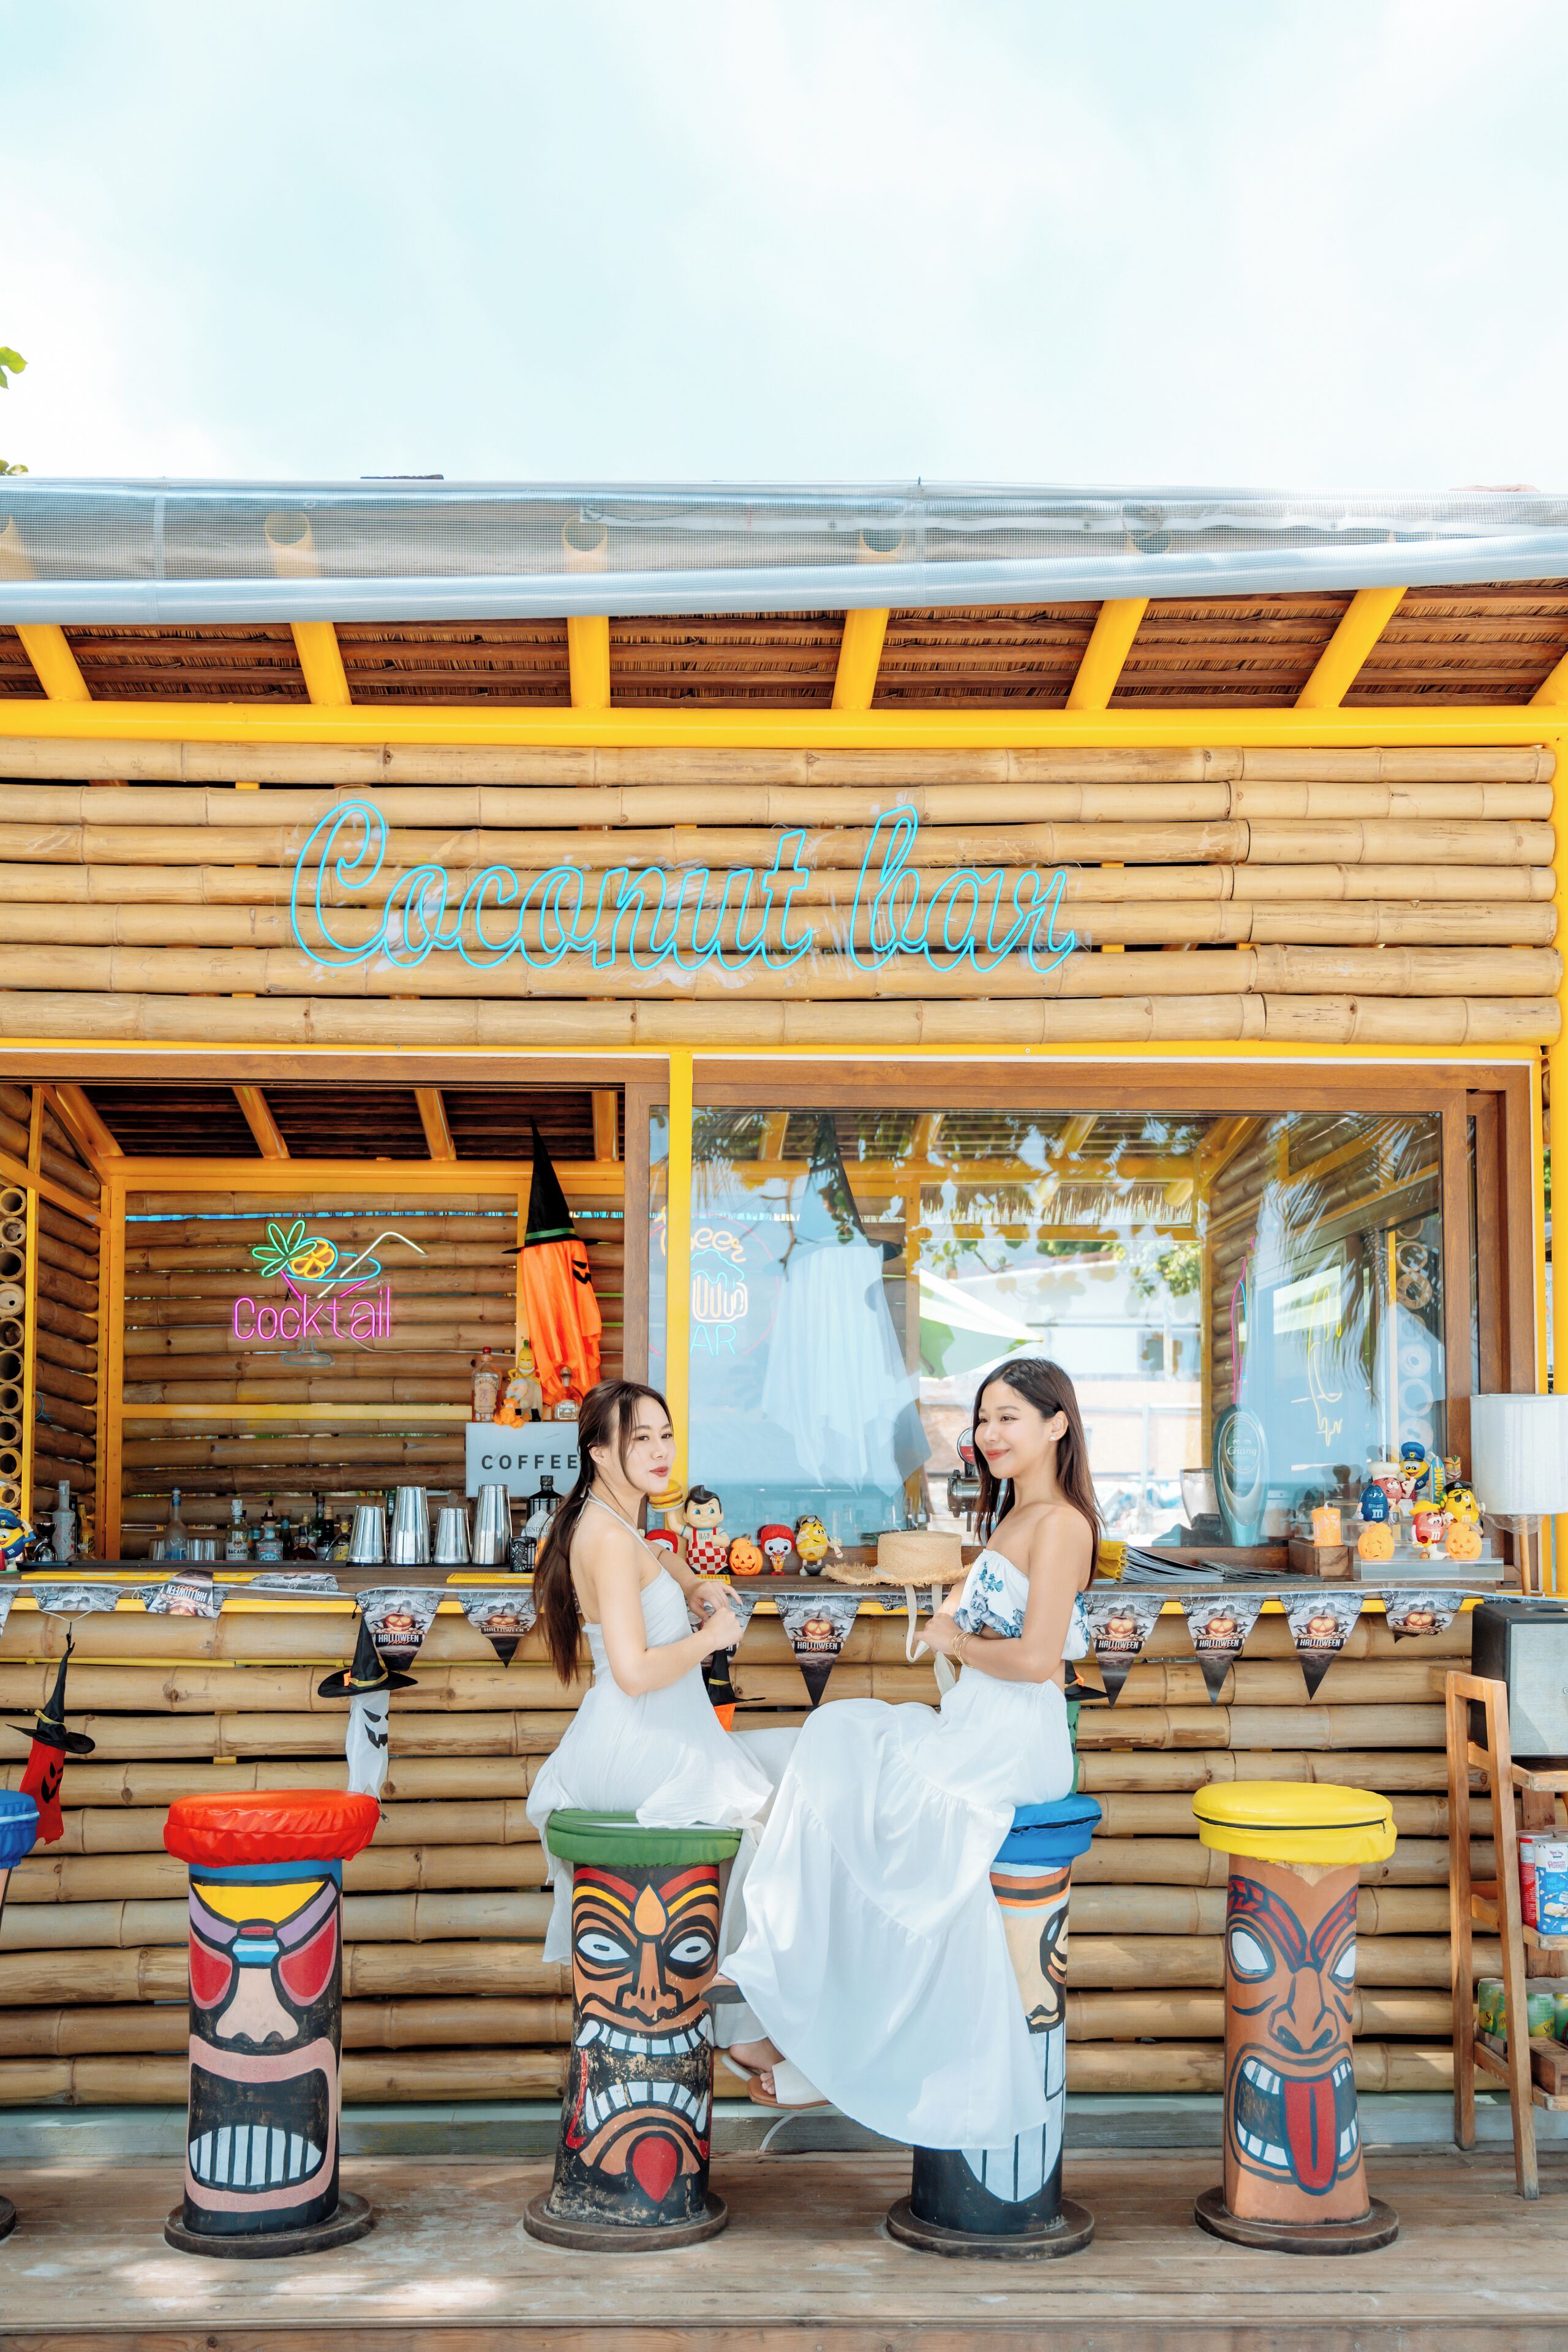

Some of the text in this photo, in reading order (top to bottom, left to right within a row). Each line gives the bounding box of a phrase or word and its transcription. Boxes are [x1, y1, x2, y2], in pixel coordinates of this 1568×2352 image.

[290, 799, 1077, 974] Coconut bar
[233, 1286, 390, 1340] Cocktail
[690, 1325, 735, 1355] AR
[1227, 1446, 1257, 1457] Chang
[481, 1455, 578, 1469] COFFEE
[166, 1584, 207, 1602] HALLOWEEN
[378, 1634, 419, 1643] HALLOWEEN
[1199, 1638, 1239, 1648] HALLOWEEN
[1300, 1638, 1340, 1647] HALLOWEEN
[797, 1642, 837, 1650] HALLOWEEN
[1098, 1640, 1139, 1649] HALLOWEEN
